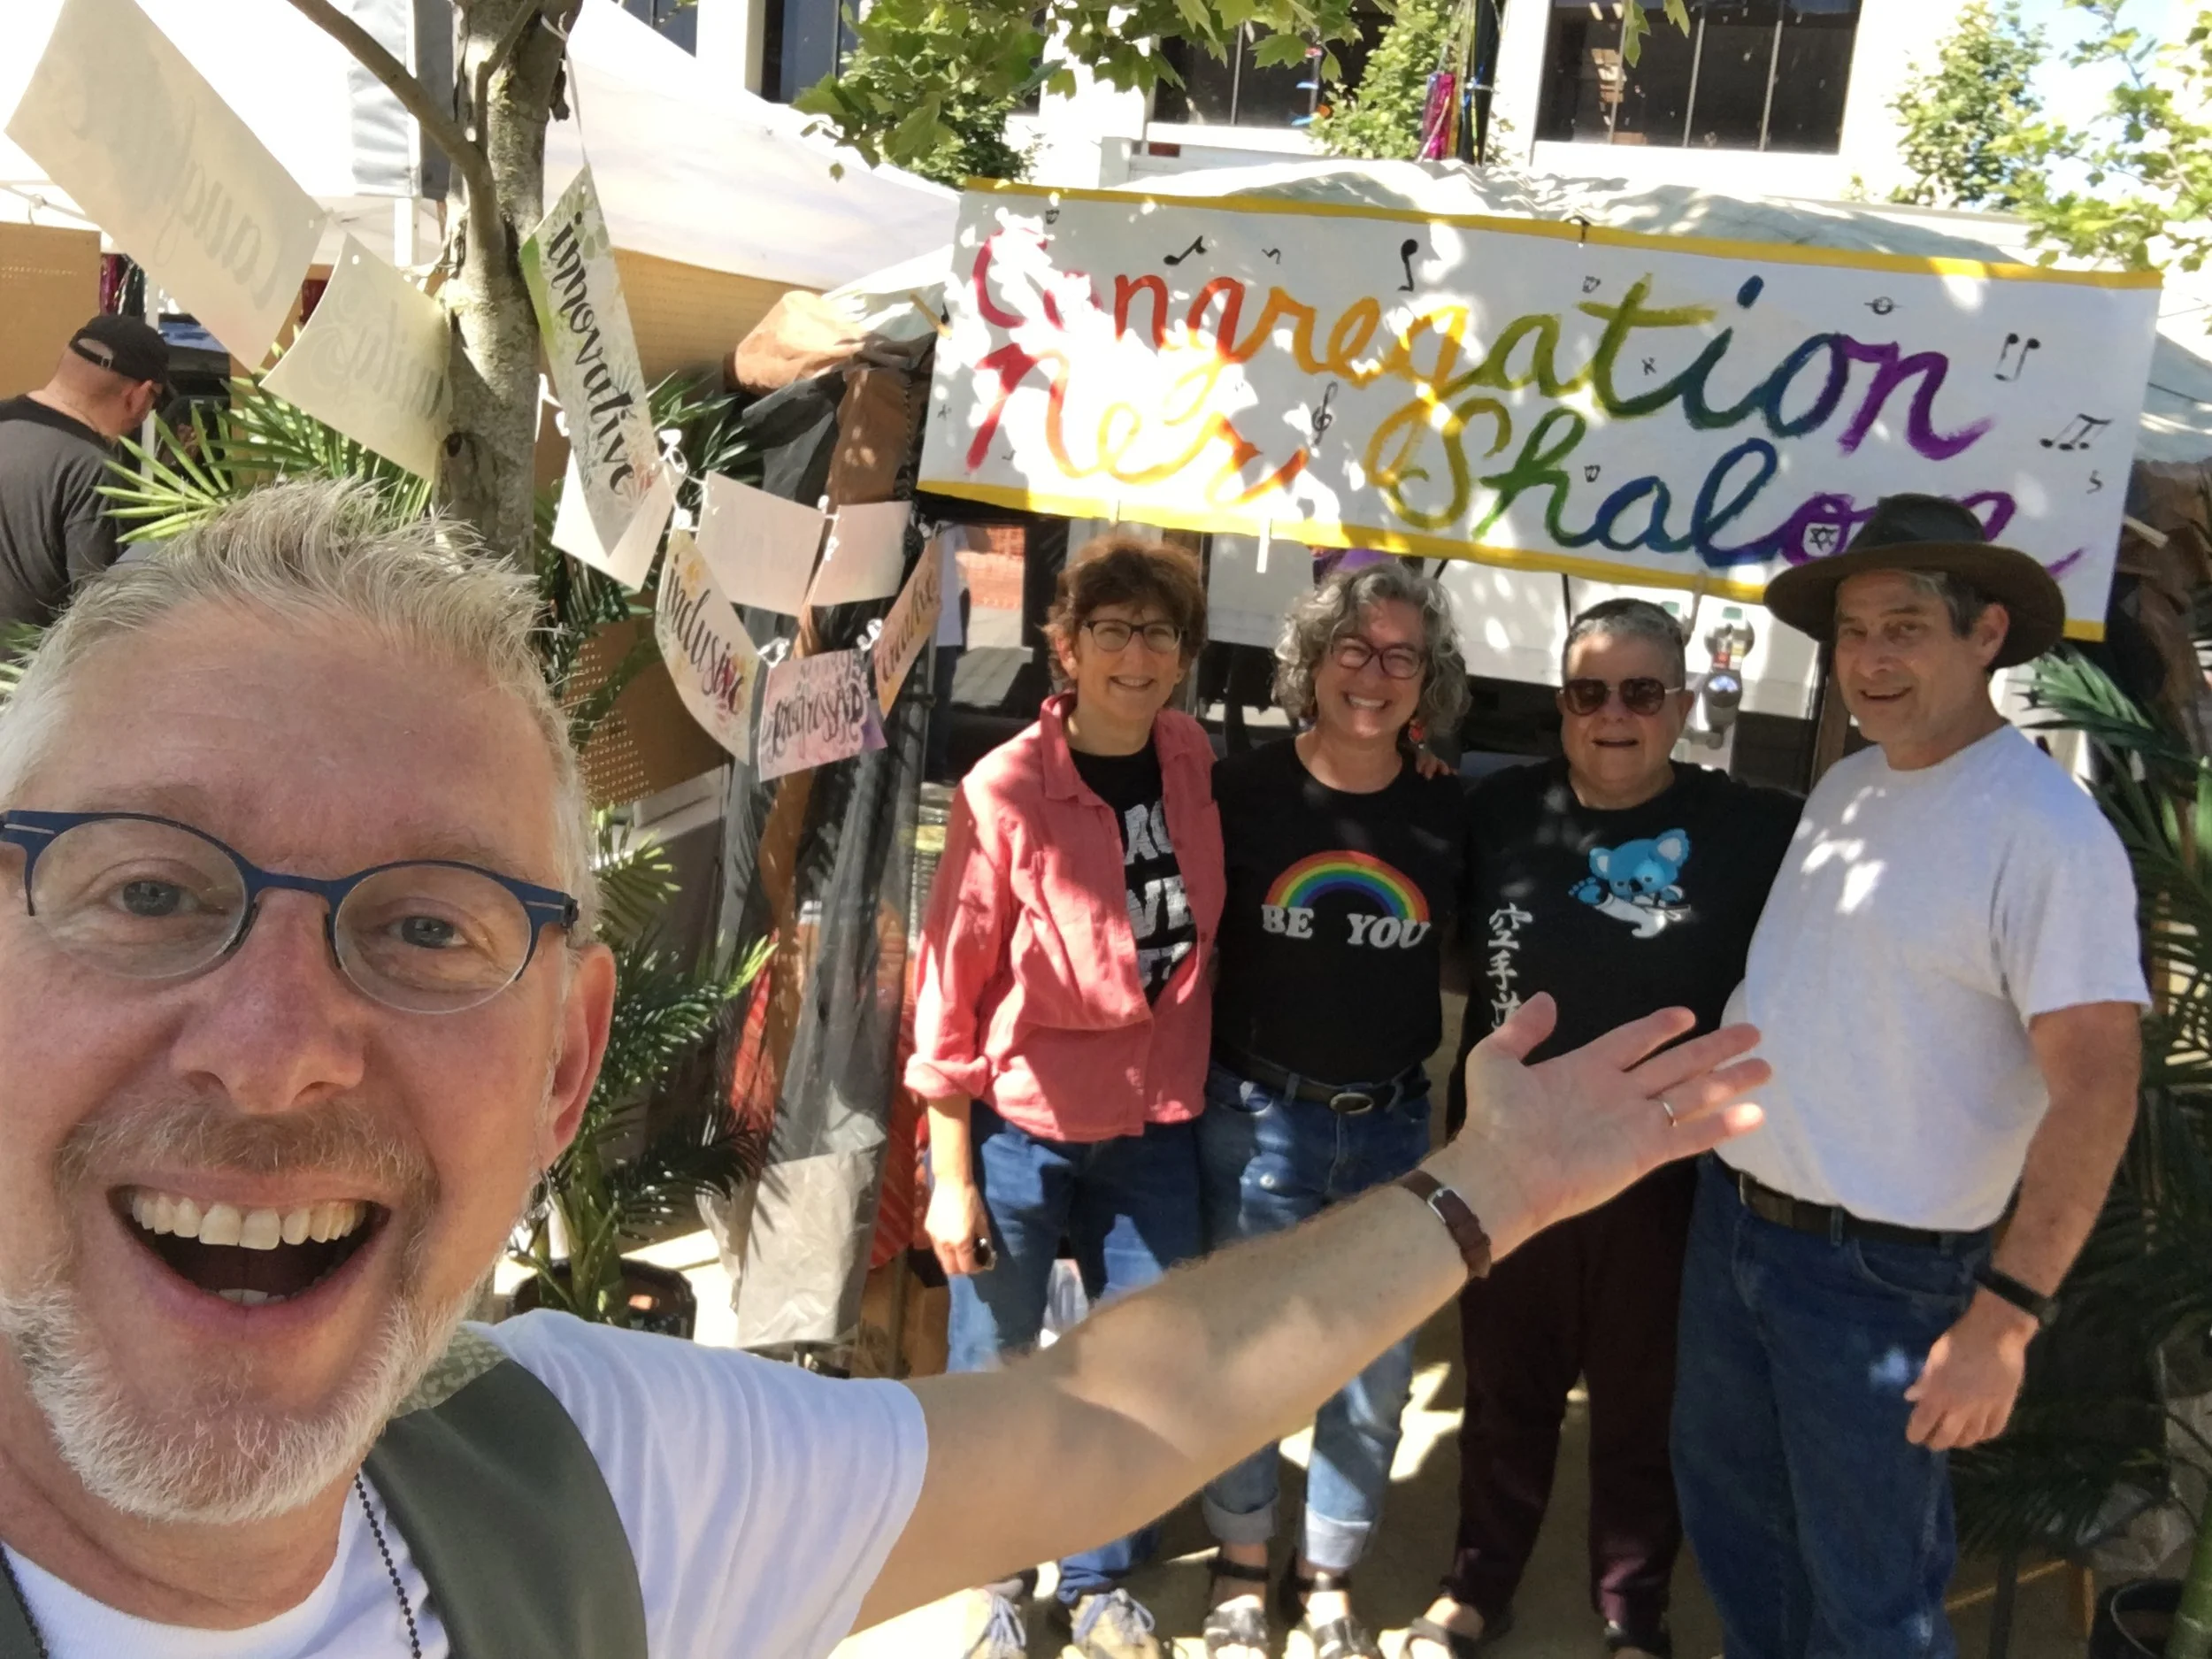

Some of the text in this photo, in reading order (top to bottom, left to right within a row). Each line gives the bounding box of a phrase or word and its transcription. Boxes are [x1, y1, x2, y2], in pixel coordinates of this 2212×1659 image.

[546, 210, 637, 496] innovative
[1262, 904, 1431, 949] BE YOU
